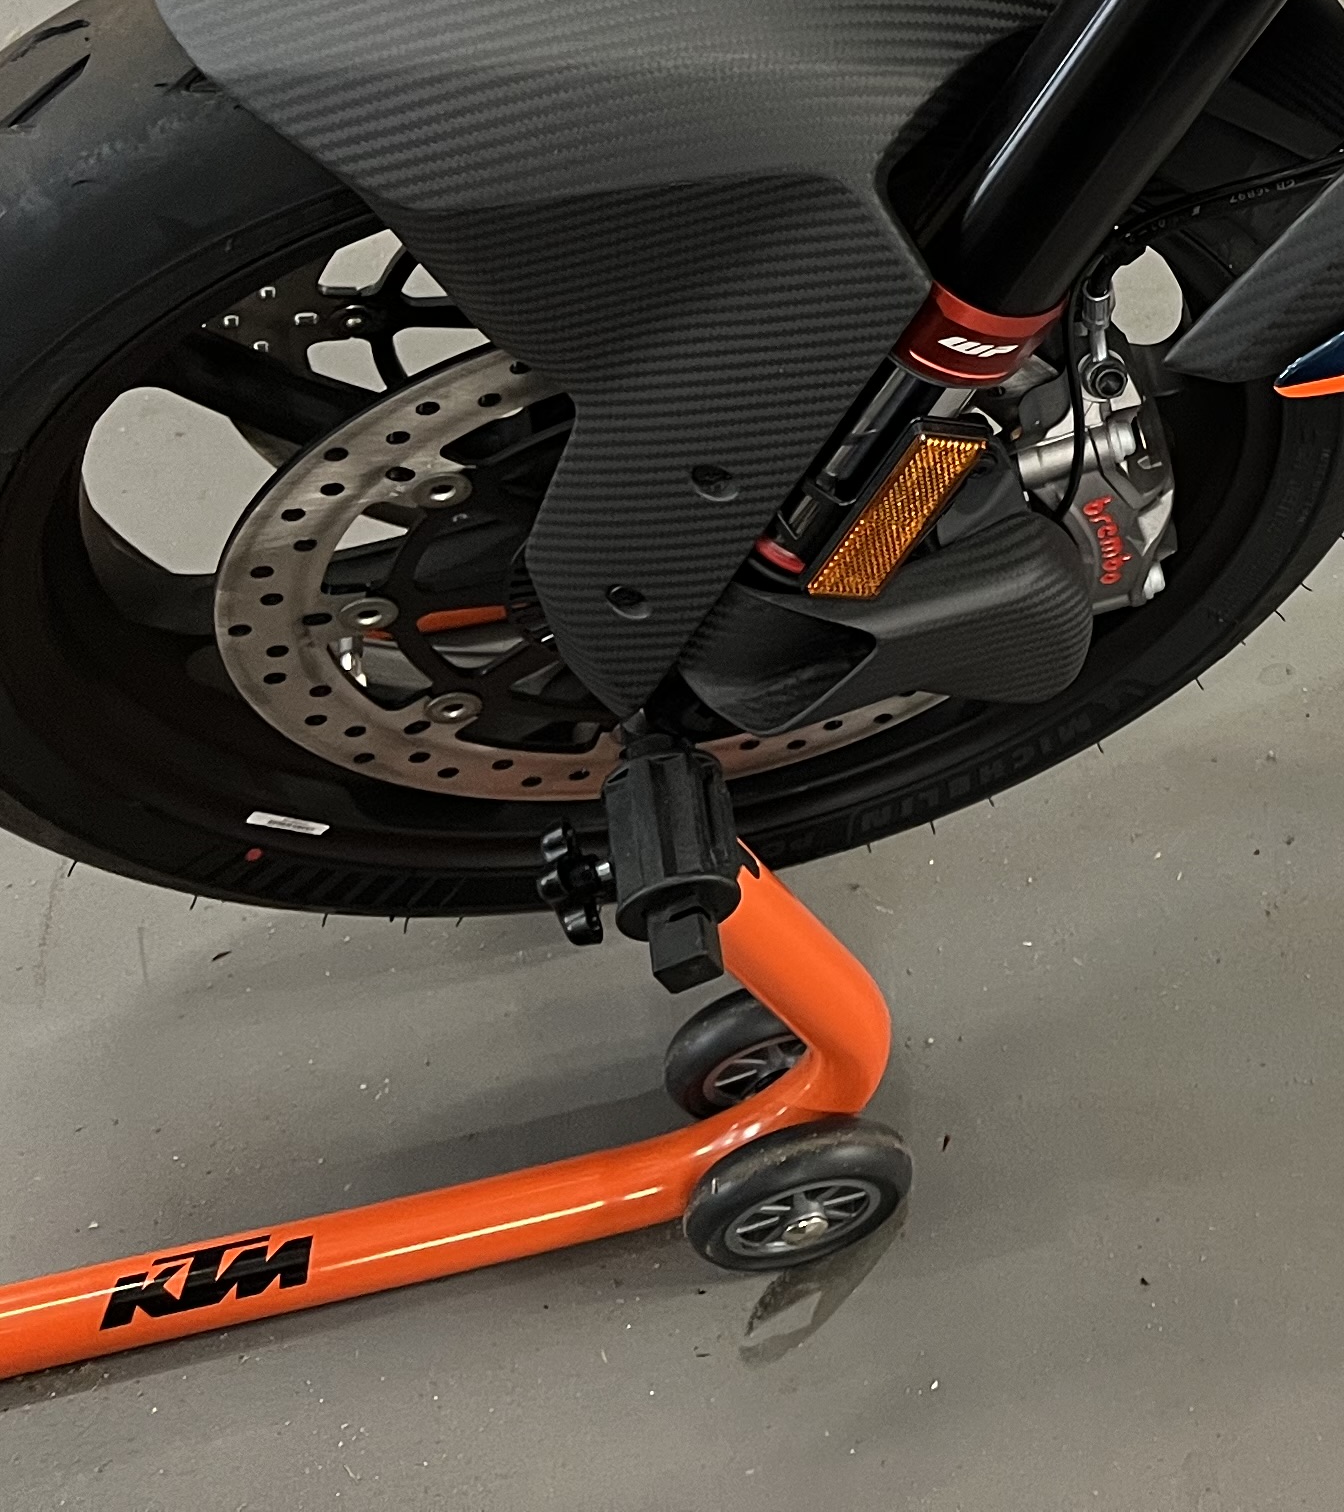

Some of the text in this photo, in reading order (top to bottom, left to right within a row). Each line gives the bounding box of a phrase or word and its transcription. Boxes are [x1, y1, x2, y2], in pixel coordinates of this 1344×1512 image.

[1081, 494, 1133, 587] brembo
[860, 710, 1093, 833] MICHELIN
[100, 1234, 313, 1331] KTM
